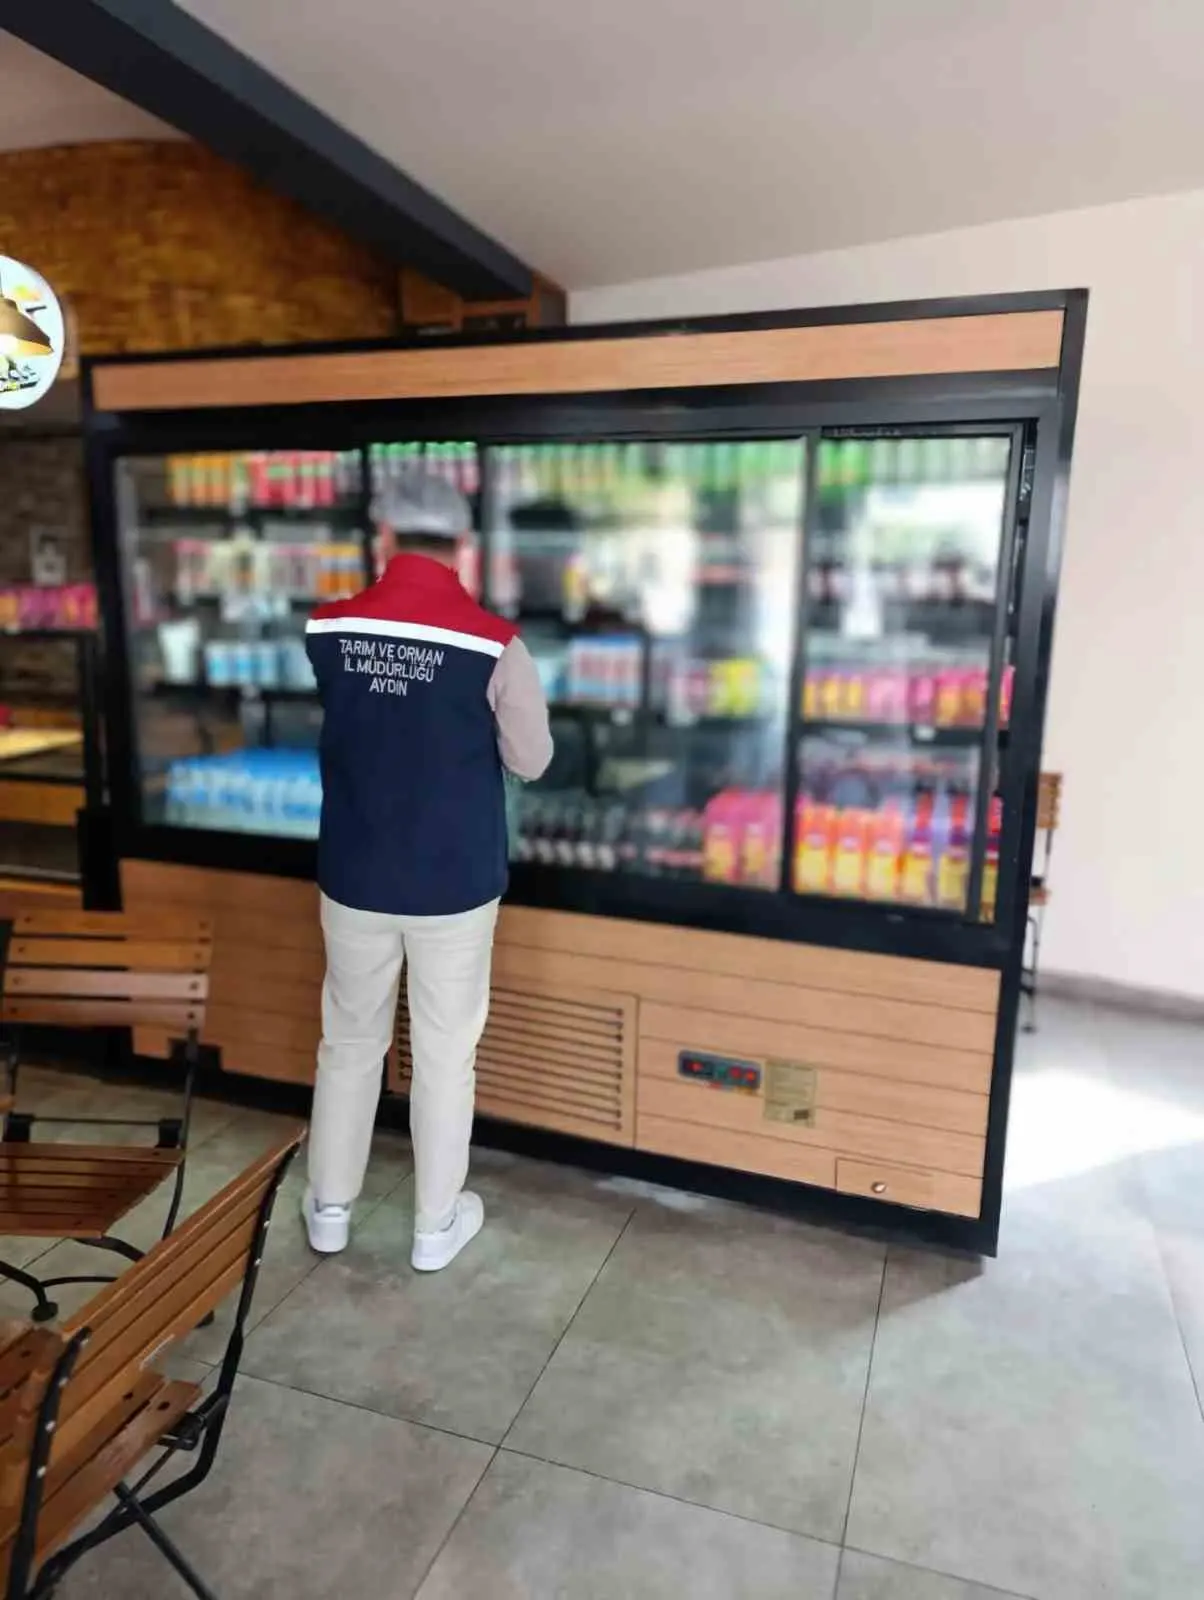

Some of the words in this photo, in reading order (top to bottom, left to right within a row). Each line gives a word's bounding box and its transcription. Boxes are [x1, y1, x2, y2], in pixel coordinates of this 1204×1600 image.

[339, 639, 376, 657] TARIM
[379, 643, 396, 659] VE
[397, 645, 444, 666] ORMAN
[369, 677, 408, 696] AYDIN
